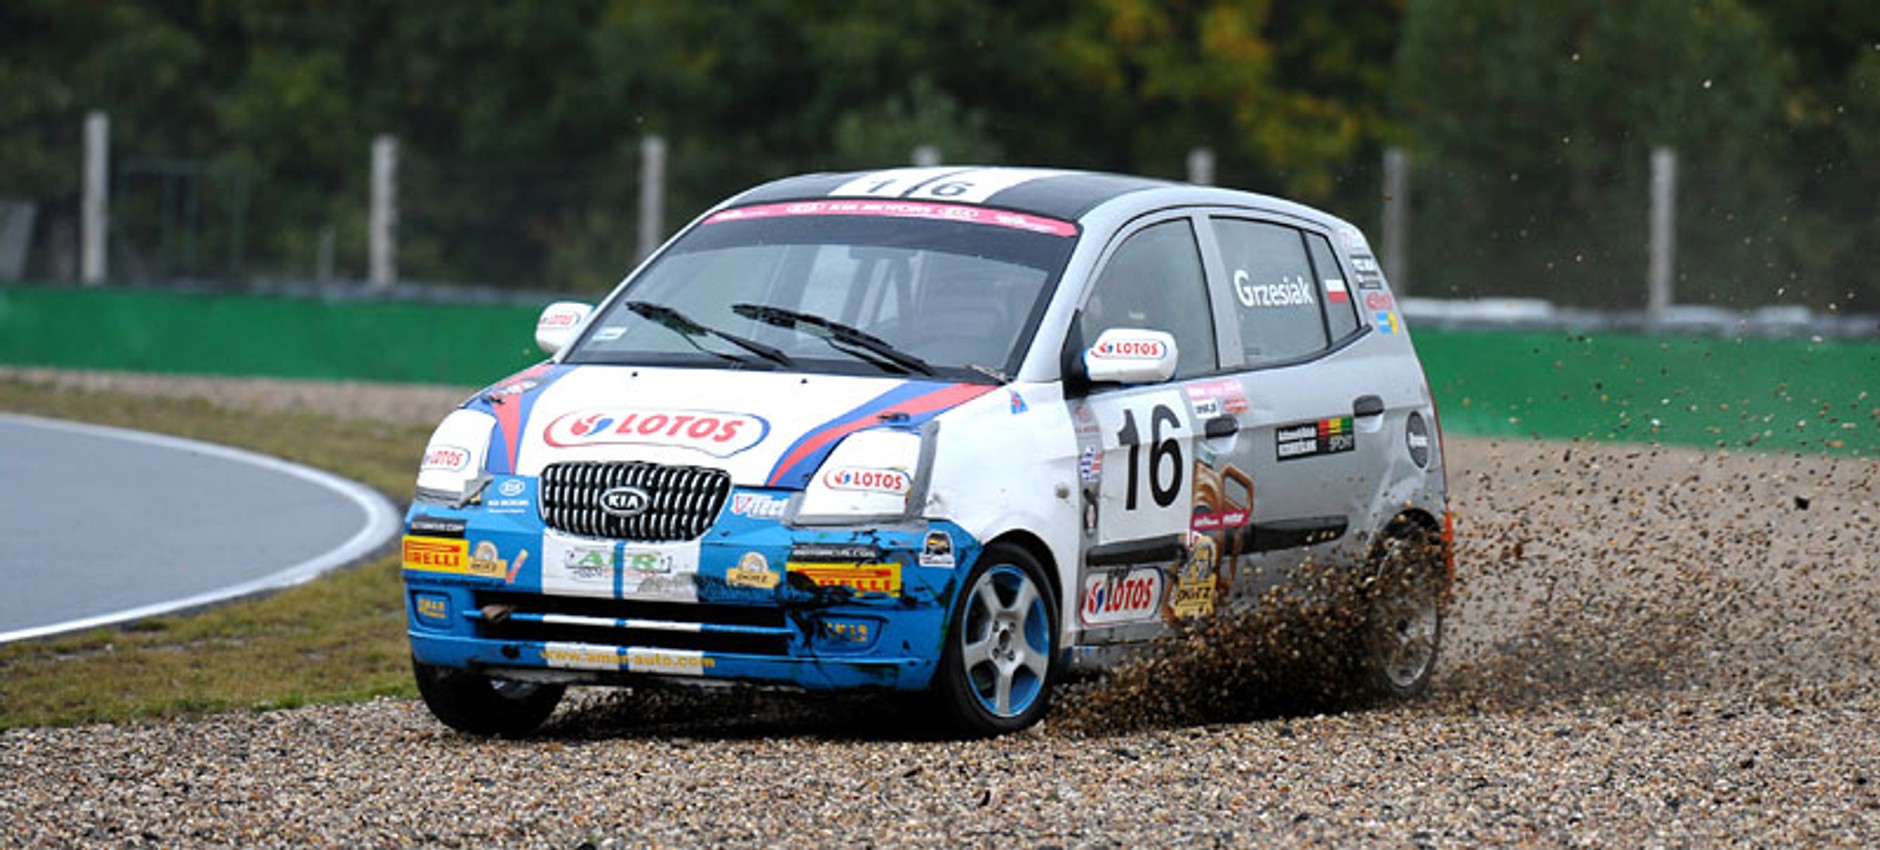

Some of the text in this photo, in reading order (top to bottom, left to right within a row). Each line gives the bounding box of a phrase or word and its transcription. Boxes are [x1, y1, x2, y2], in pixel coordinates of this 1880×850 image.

[1233, 269, 1313, 307] Grzesiak
[1116, 342, 1158, 356] LOTOS
[615, 413, 745, 443] LOTOS
[1116, 403, 1184, 512] 16
[853, 471, 903, 490] LOTOS
[608, 494, 639, 509] KIA
[1103, 577, 1154, 613] LOTOS
[540, 651, 716, 668] www.amar-auto.com
